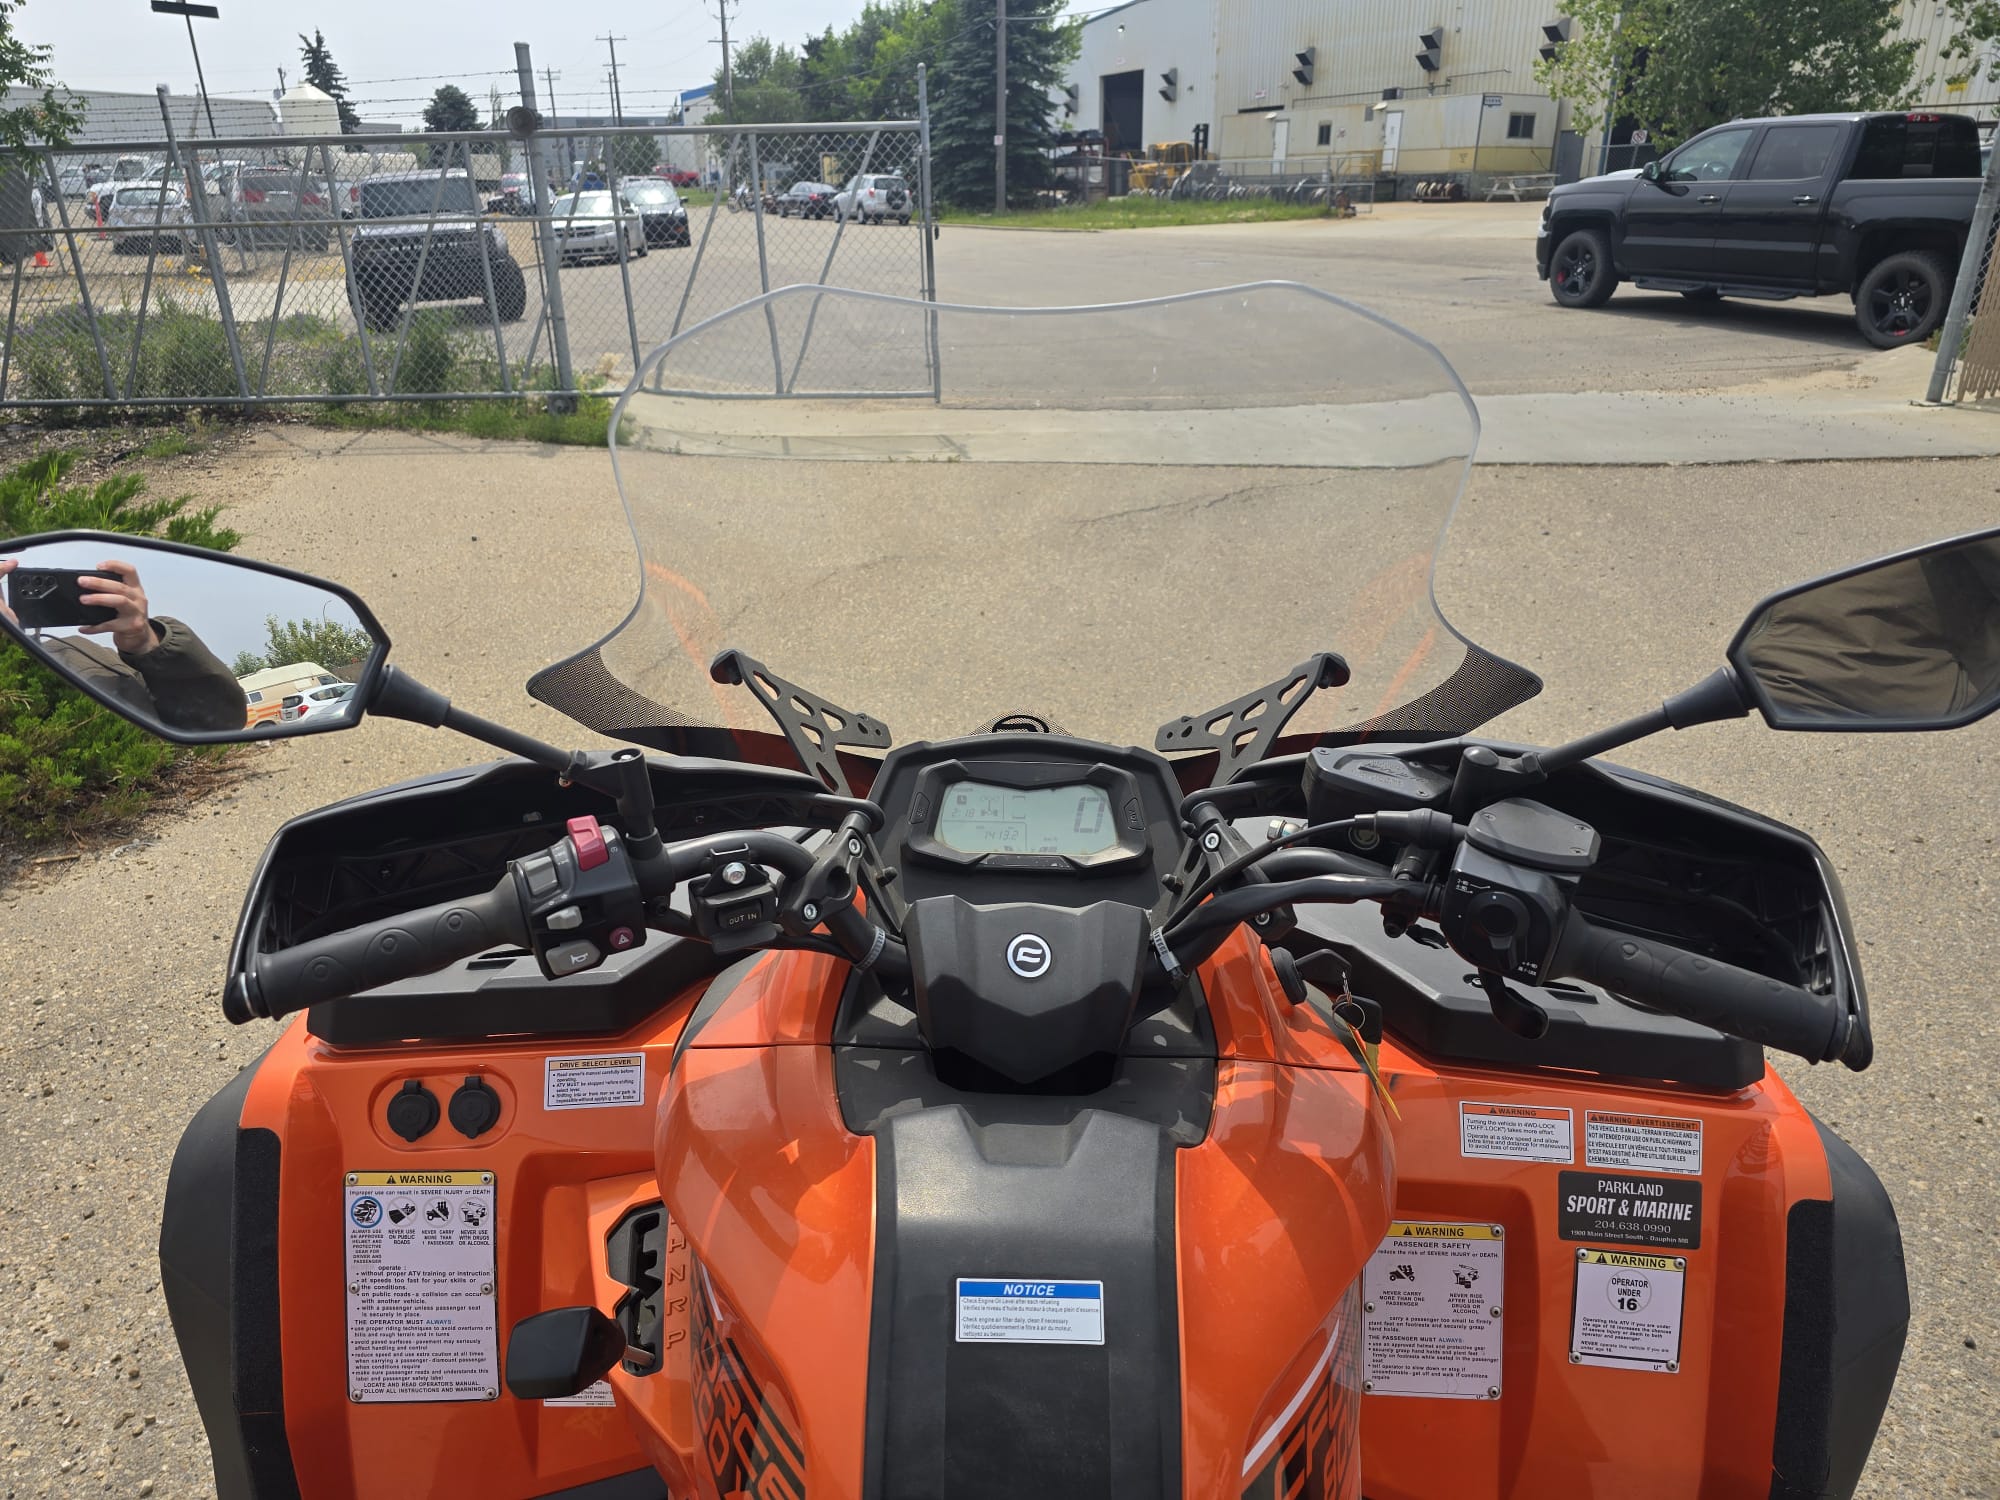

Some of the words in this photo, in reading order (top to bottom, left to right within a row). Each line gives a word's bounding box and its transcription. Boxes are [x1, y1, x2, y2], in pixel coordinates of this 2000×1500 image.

[1073, 796, 1106, 834] 0
[729, 915, 745, 924] OUT
[1599, 1115, 1631, 1123] WARNING
[1636, 1118, 1697, 1129] AVERTISSEMENT
[1632, 1128, 1662, 1136] ALL-TERRAIN
[1659, 1146, 1691, 1155] TOUT-TERRAIN
[1598, 1181, 1663, 1196] PARKLAND
[1567, 1196, 1614, 1214] SPORT
[1619, 1200, 1628, 1215] &
[1634, 1201, 1693, 1220] MARINE
[1416, 1227, 1464, 1237] WARNING
[1595, 1221, 1670, 1233] 204.638.0990
[1611, 1255, 1665, 1268] WARNING
[1612, 1278, 1648, 1288] OPERATOR
[1004, 1284, 1055, 1296] NOTICE
[1618, 1289, 1641, 1297] UNDER
[1618, 1298, 1637, 1310] 16
